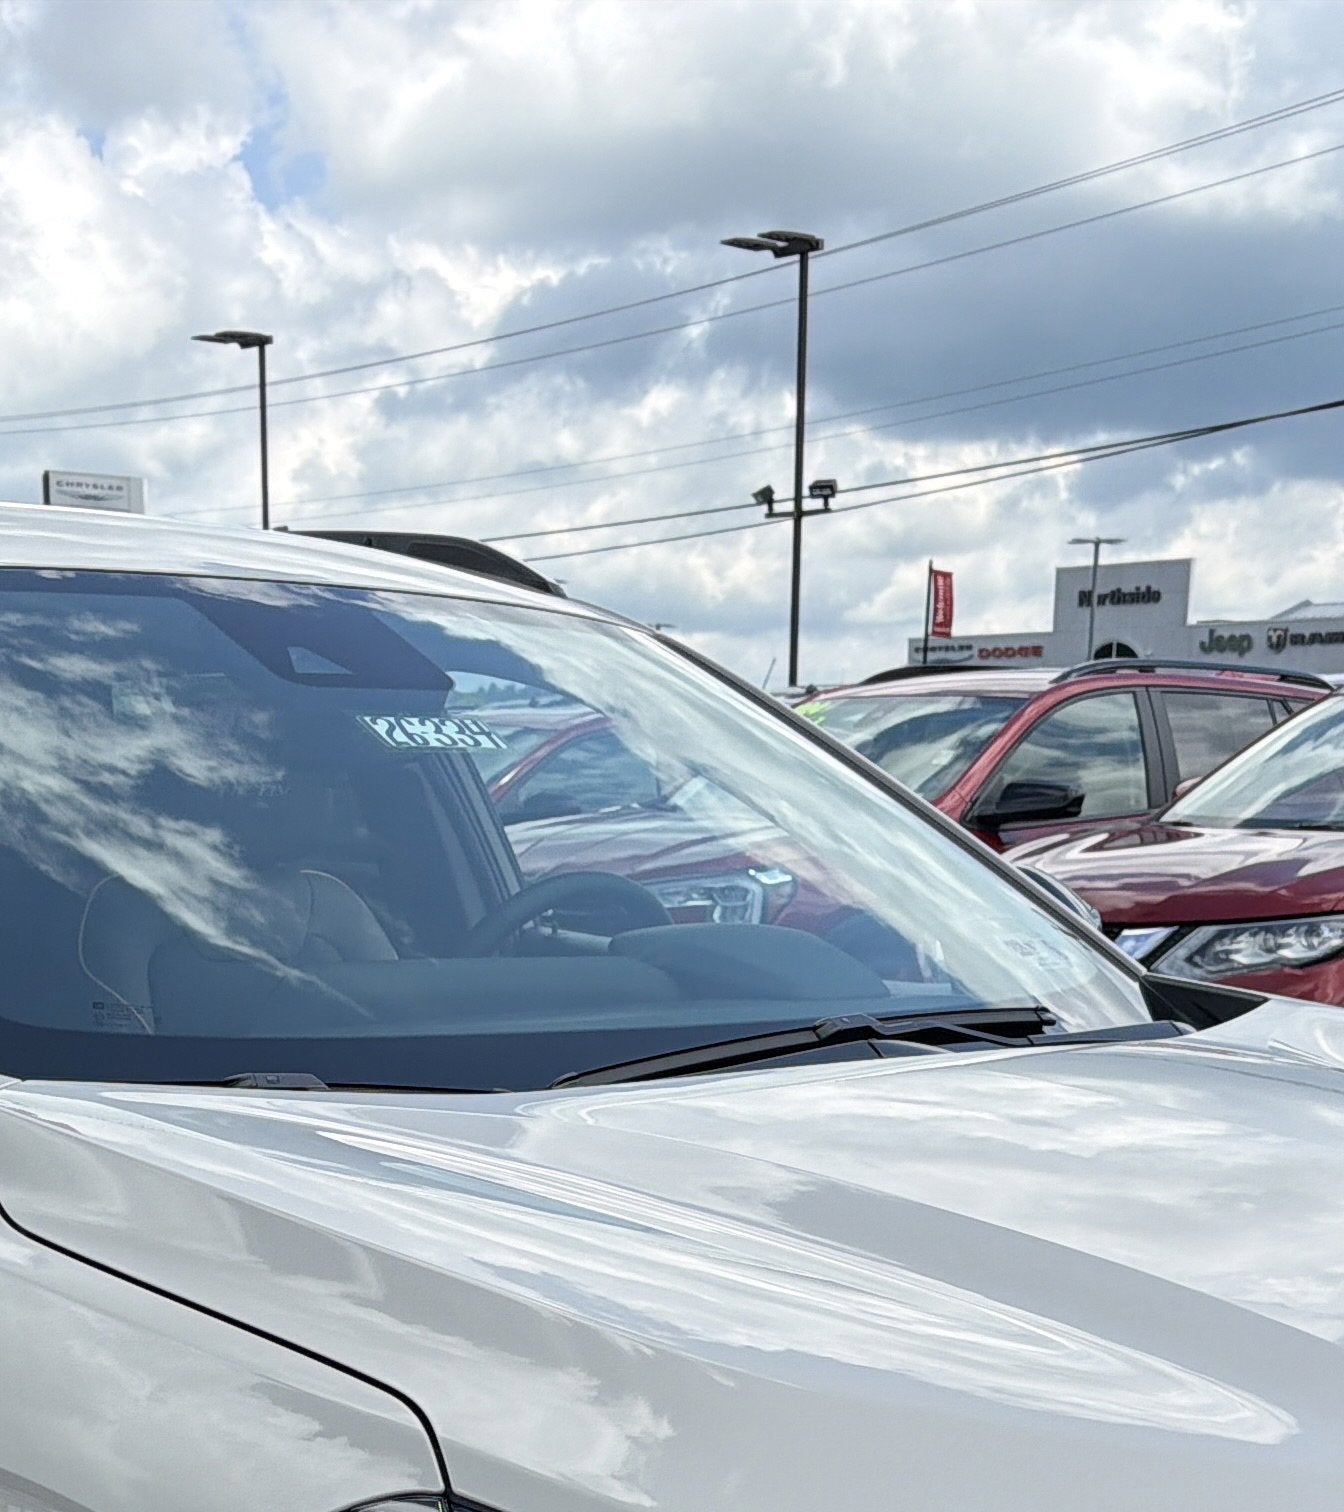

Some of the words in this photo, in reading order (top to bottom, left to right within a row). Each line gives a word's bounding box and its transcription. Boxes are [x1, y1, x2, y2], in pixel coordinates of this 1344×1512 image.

[56, 480, 124, 492] CHRYSLER
[1199, 628, 1254, 657] Jeep
[977, 645, 1044, 659] DODGE
